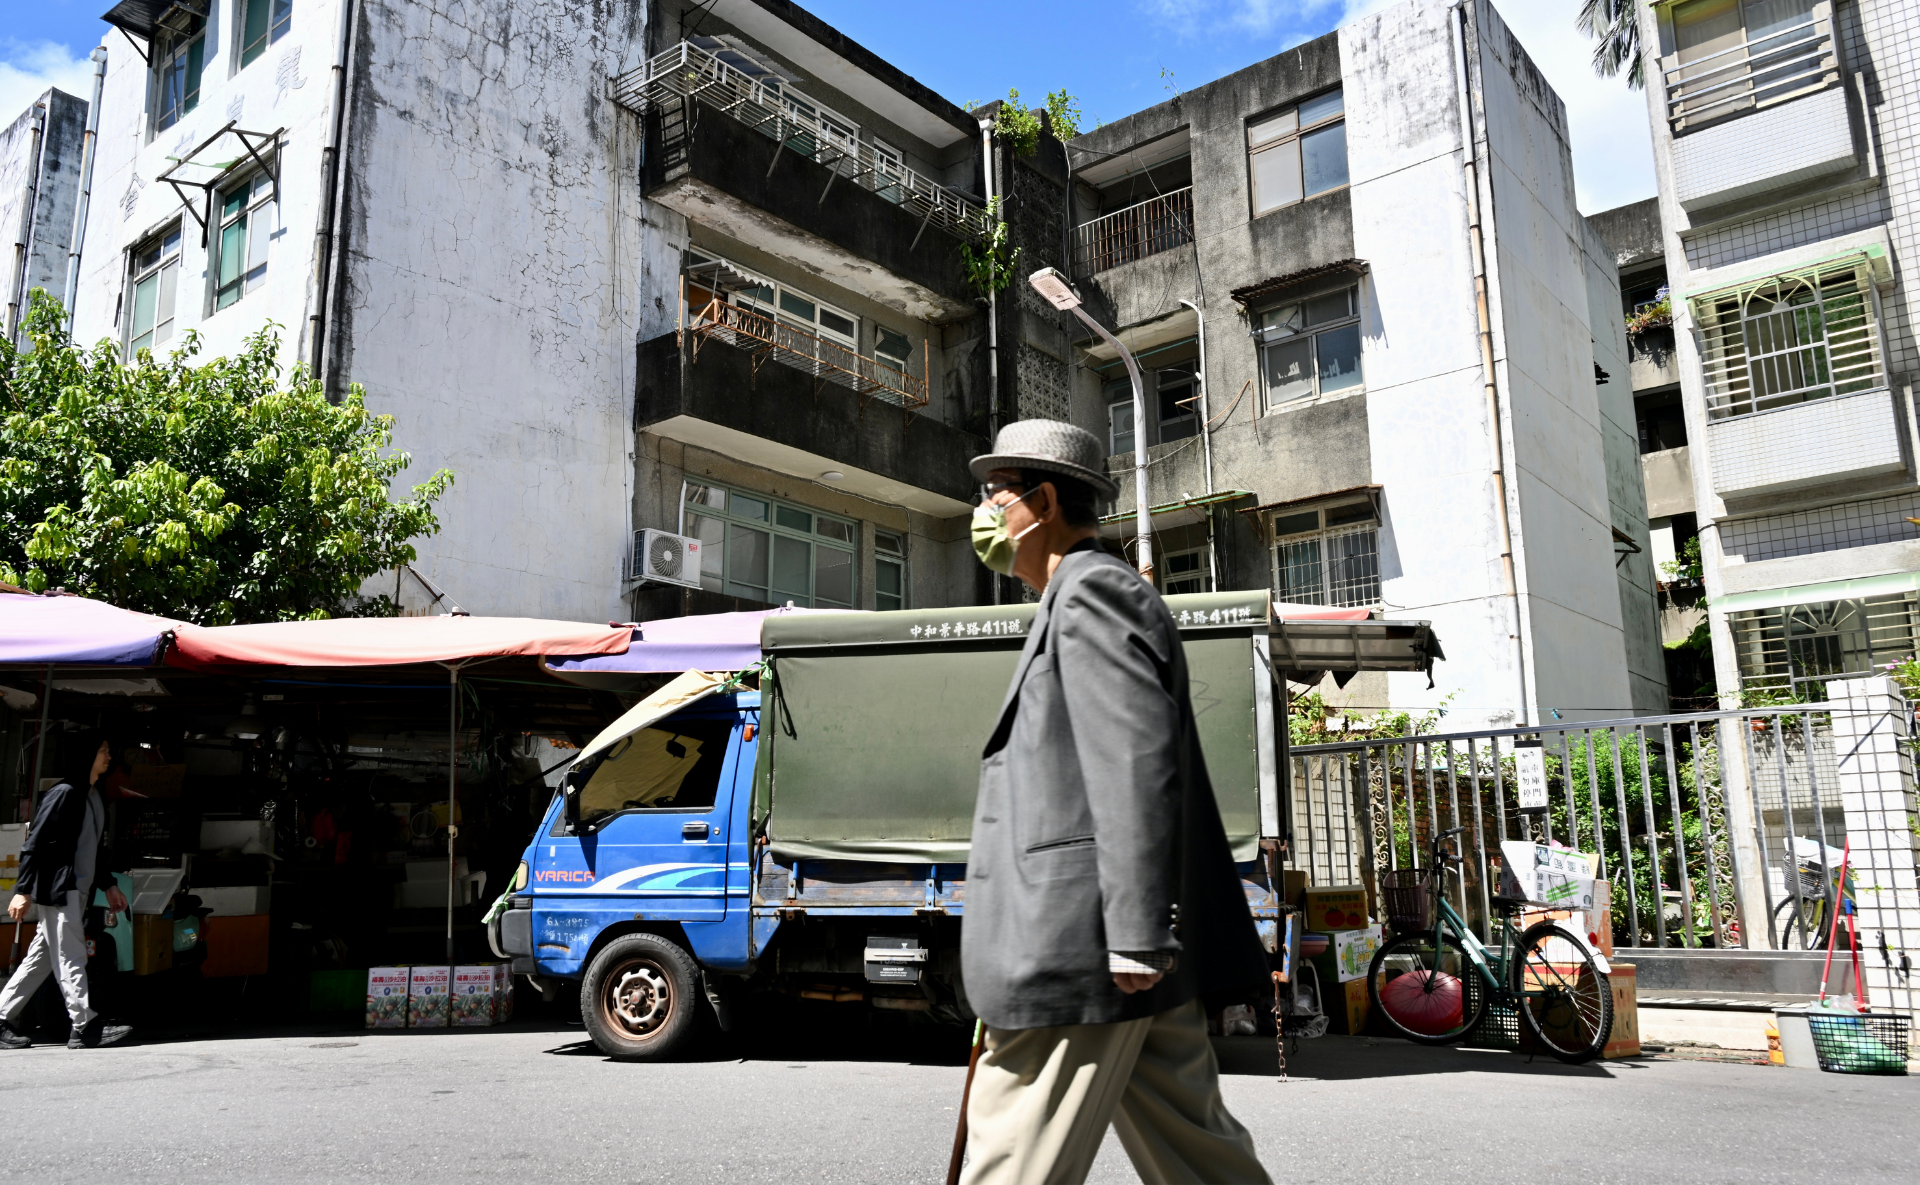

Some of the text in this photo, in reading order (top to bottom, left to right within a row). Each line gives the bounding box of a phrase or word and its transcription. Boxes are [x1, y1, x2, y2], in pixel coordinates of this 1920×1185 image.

[910, 618, 1023, 638] 中和景平路411號
[535, 871, 595, 882] VARICA
